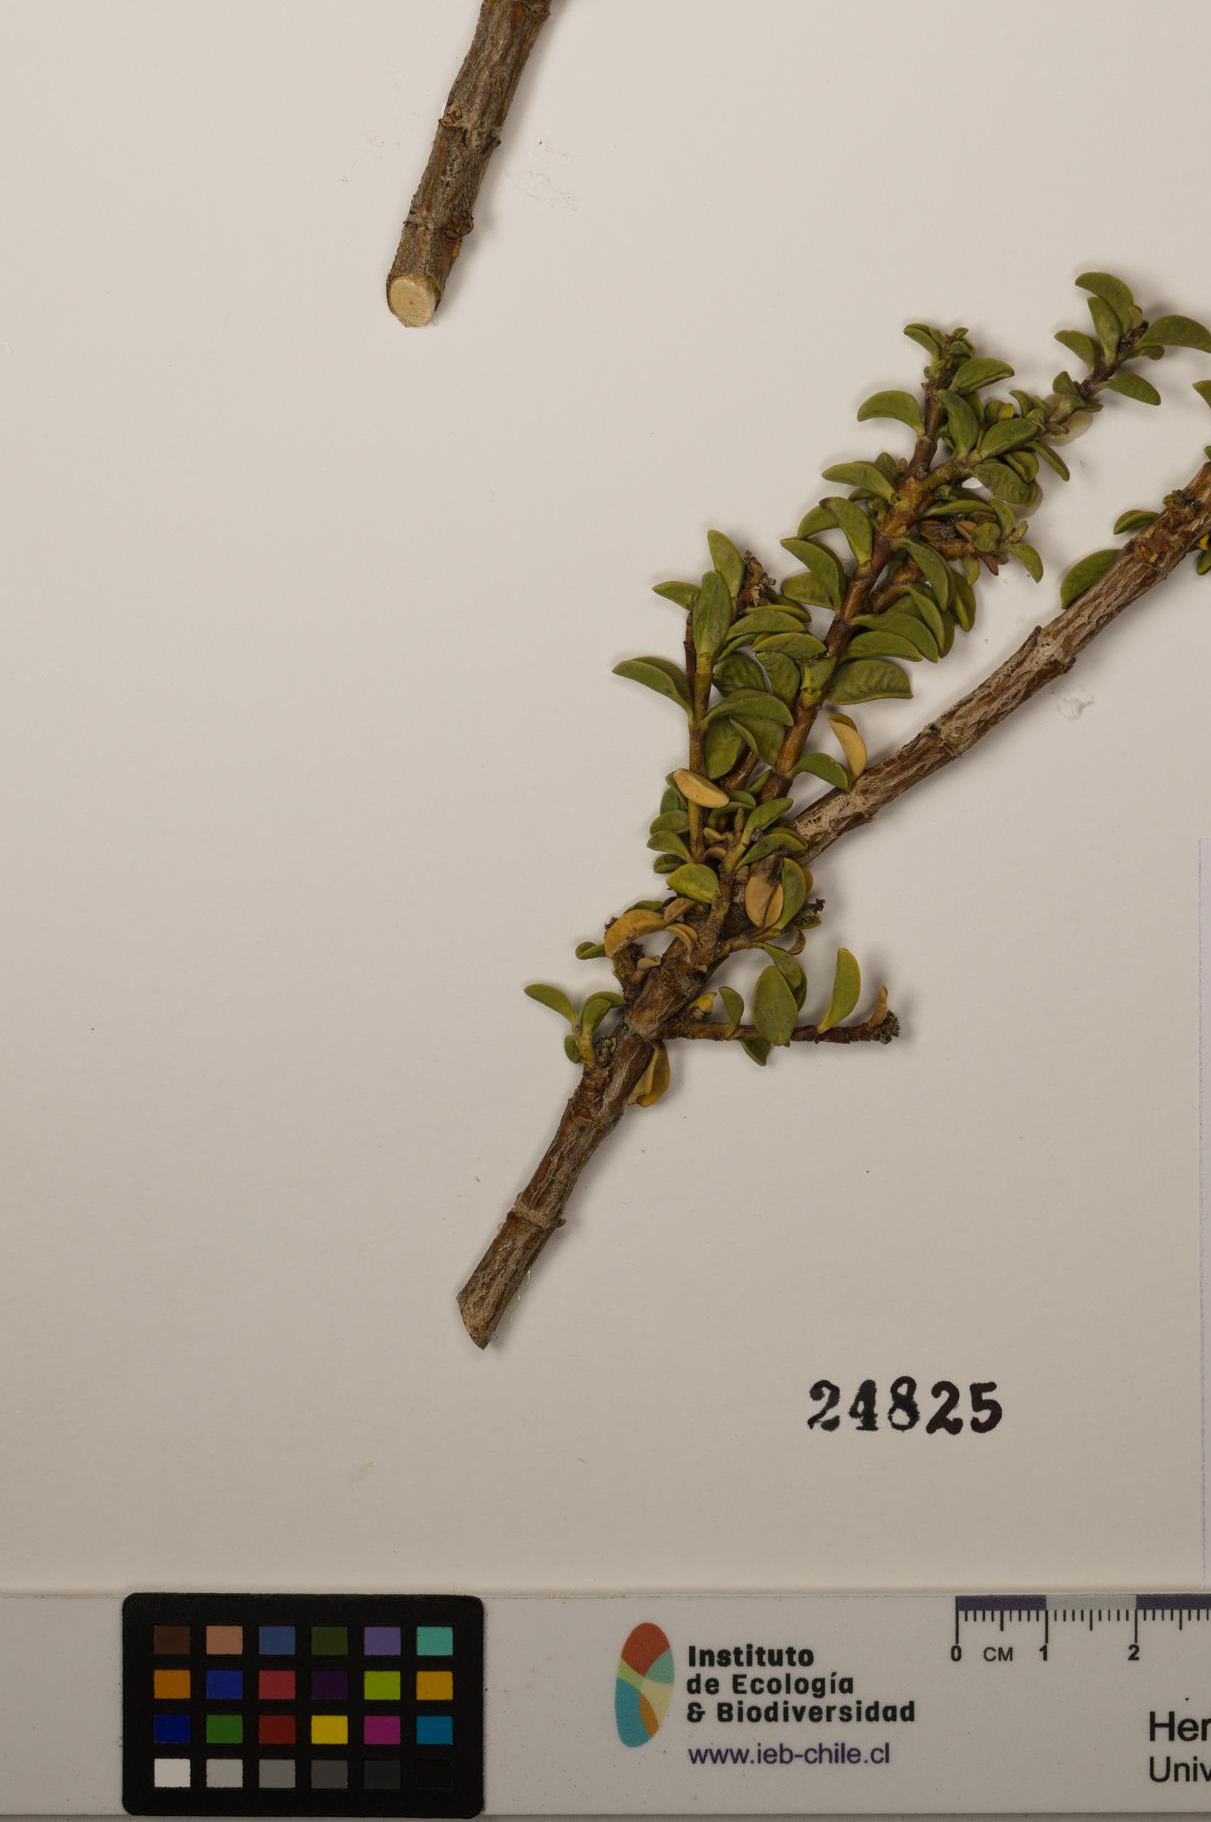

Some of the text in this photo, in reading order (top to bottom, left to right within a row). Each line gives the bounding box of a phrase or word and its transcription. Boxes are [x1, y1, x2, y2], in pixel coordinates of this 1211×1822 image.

[806, 1375, 1004, 1436] 24825
[688, 1643, 816, 1668] Instituto
[950, 1645, 962, 1663] 0
[983, 1646, 1014, 1662] CM
[1039, 1644, 1049, 1662] 1
[1127, 1644, 1140, 1662] 2
[686, 1671, 855, 1699] de Ecología
[686, 1699, 916, 1724] & Biodiversidad
[687, 1741, 891, 1766] www.ieb-chile.cl
